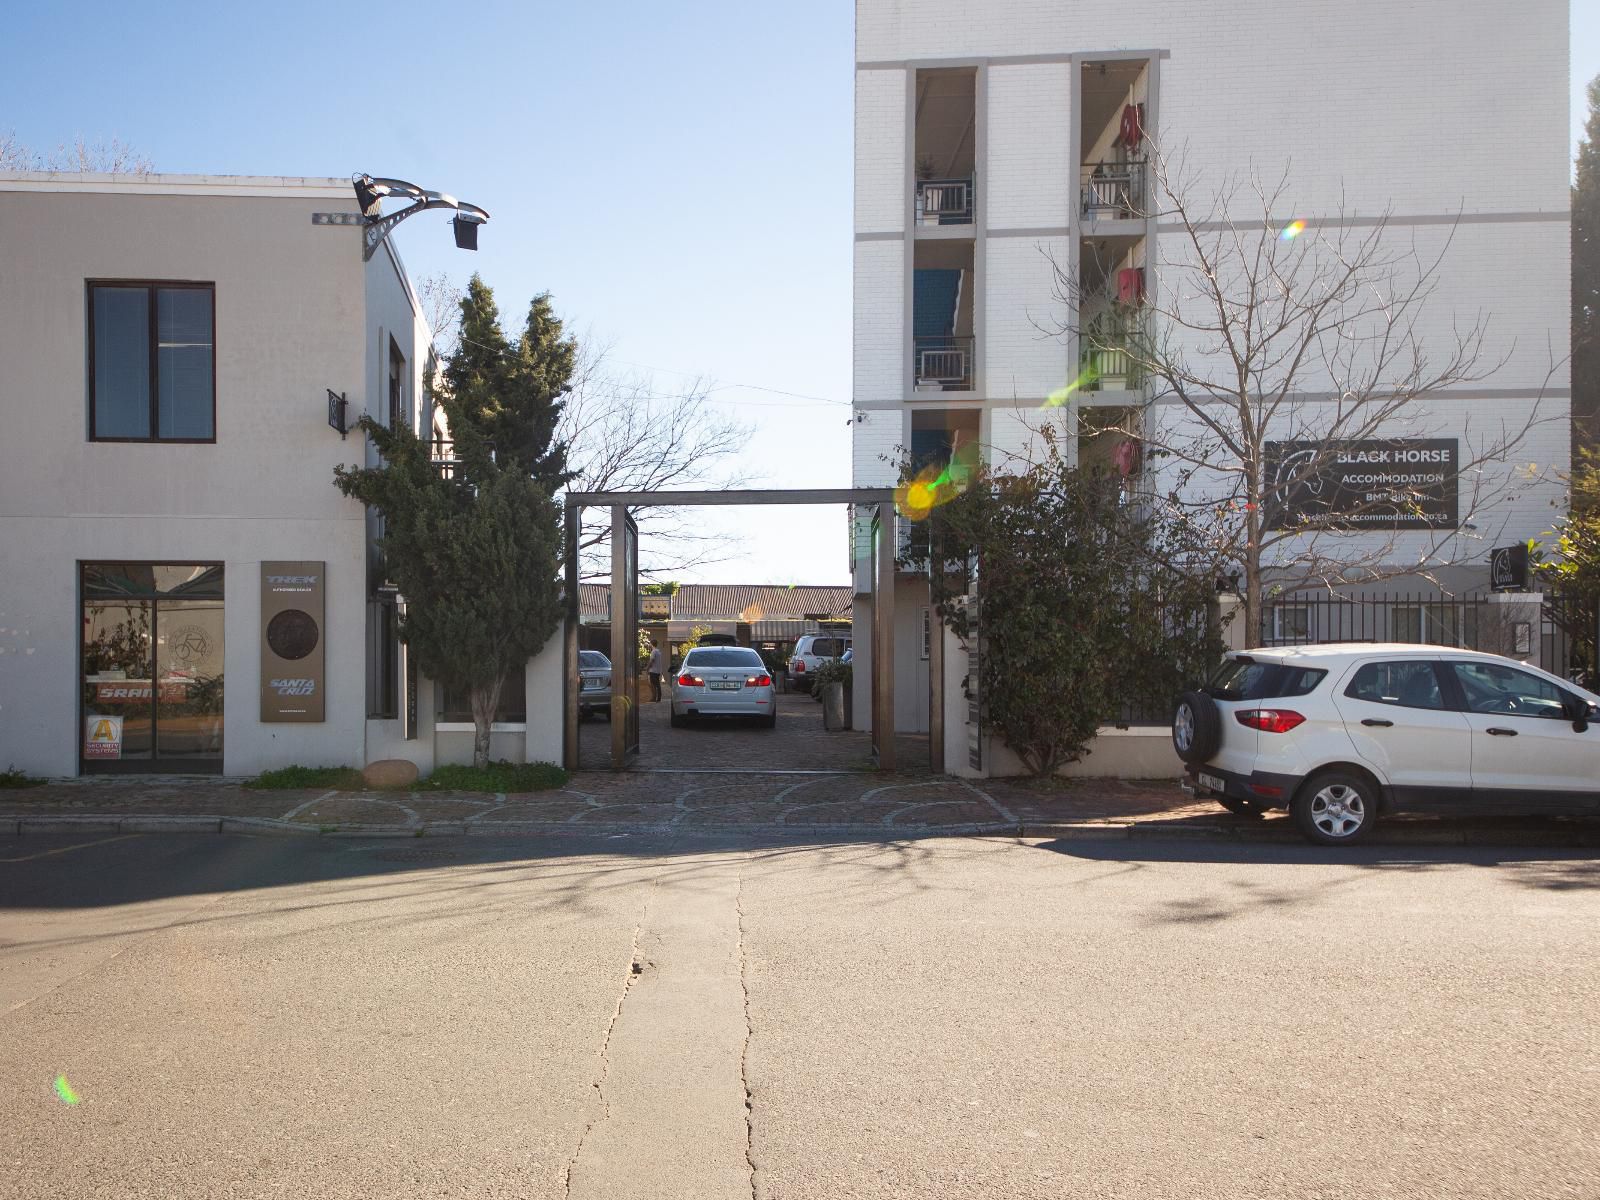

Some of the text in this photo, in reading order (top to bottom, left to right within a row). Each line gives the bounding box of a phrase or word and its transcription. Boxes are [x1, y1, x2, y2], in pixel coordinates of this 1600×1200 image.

[1338, 450, 1449, 463] BLACK HORSE
[1342, 474, 1443, 483] ACCOMMODATION
[271, 679, 315, 688] SANTA
[277, 687, 313, 695] CRUZ
